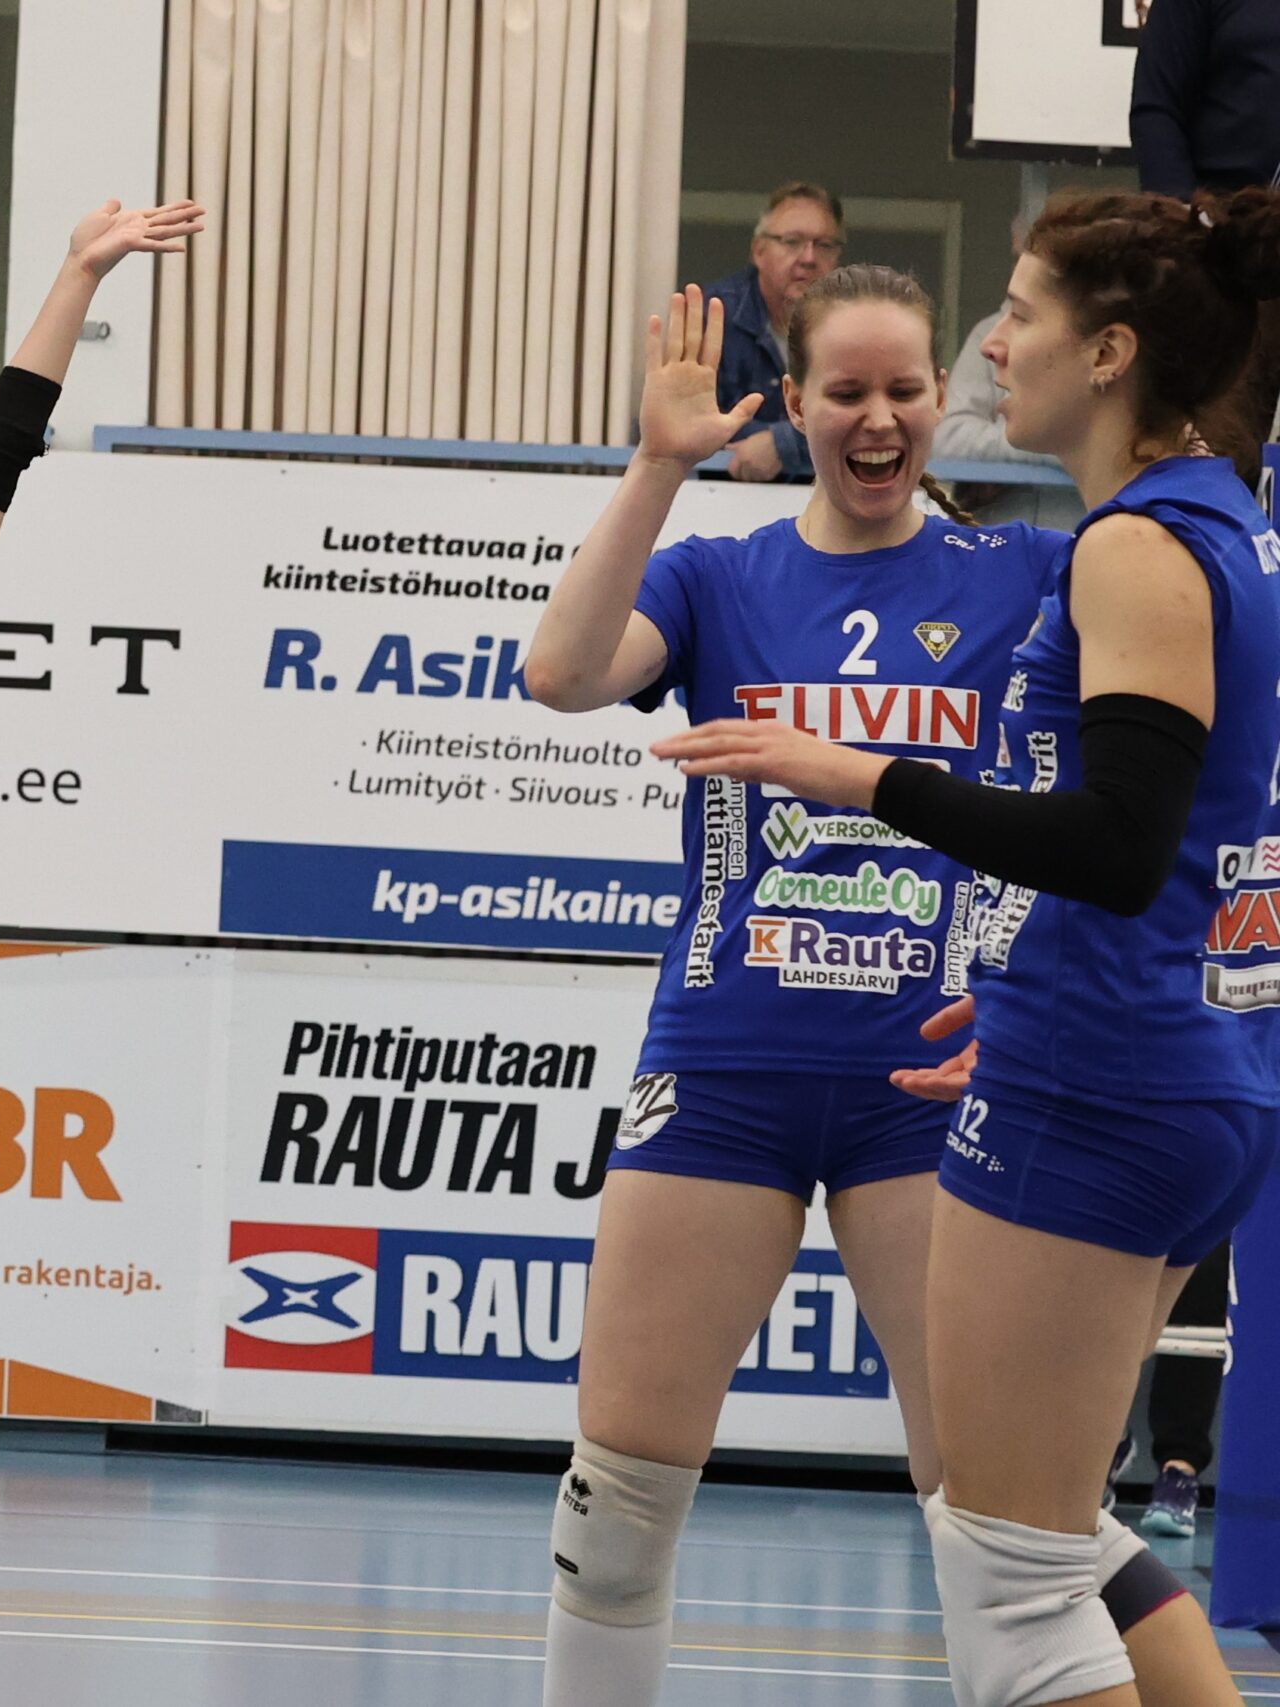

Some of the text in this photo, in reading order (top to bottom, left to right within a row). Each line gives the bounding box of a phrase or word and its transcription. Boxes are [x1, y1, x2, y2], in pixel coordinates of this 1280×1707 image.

[323, 526, 526, 560] Luotettavaa
[532, 536, 564, 566] ja
[263, 564, 551, 602] kiinteistöhuoltoa
[264, 628, 338, 692] R.
[838, 609, 880, 675] 2
[375, 729, 643, 767] Kiinteistönhuolto
[349, 769, 486, 805] Lumityöt
[509, 777, 619, 808] Siivous
[372, 869, 683, 927] kp-asikaine
[891, 872, 937, 920] Oy
[789, 921, 934, 973] Rauta
[782, 969, 895, 990] LAHDESJÄRVI
[283, 1021, 597, 1092] Pihtiputaan
[958, 1093, 989, 1143] 12
[260, 1092, 538, 1196] RAUTA
[3, 1259, 163, 1295] rakentaja.
